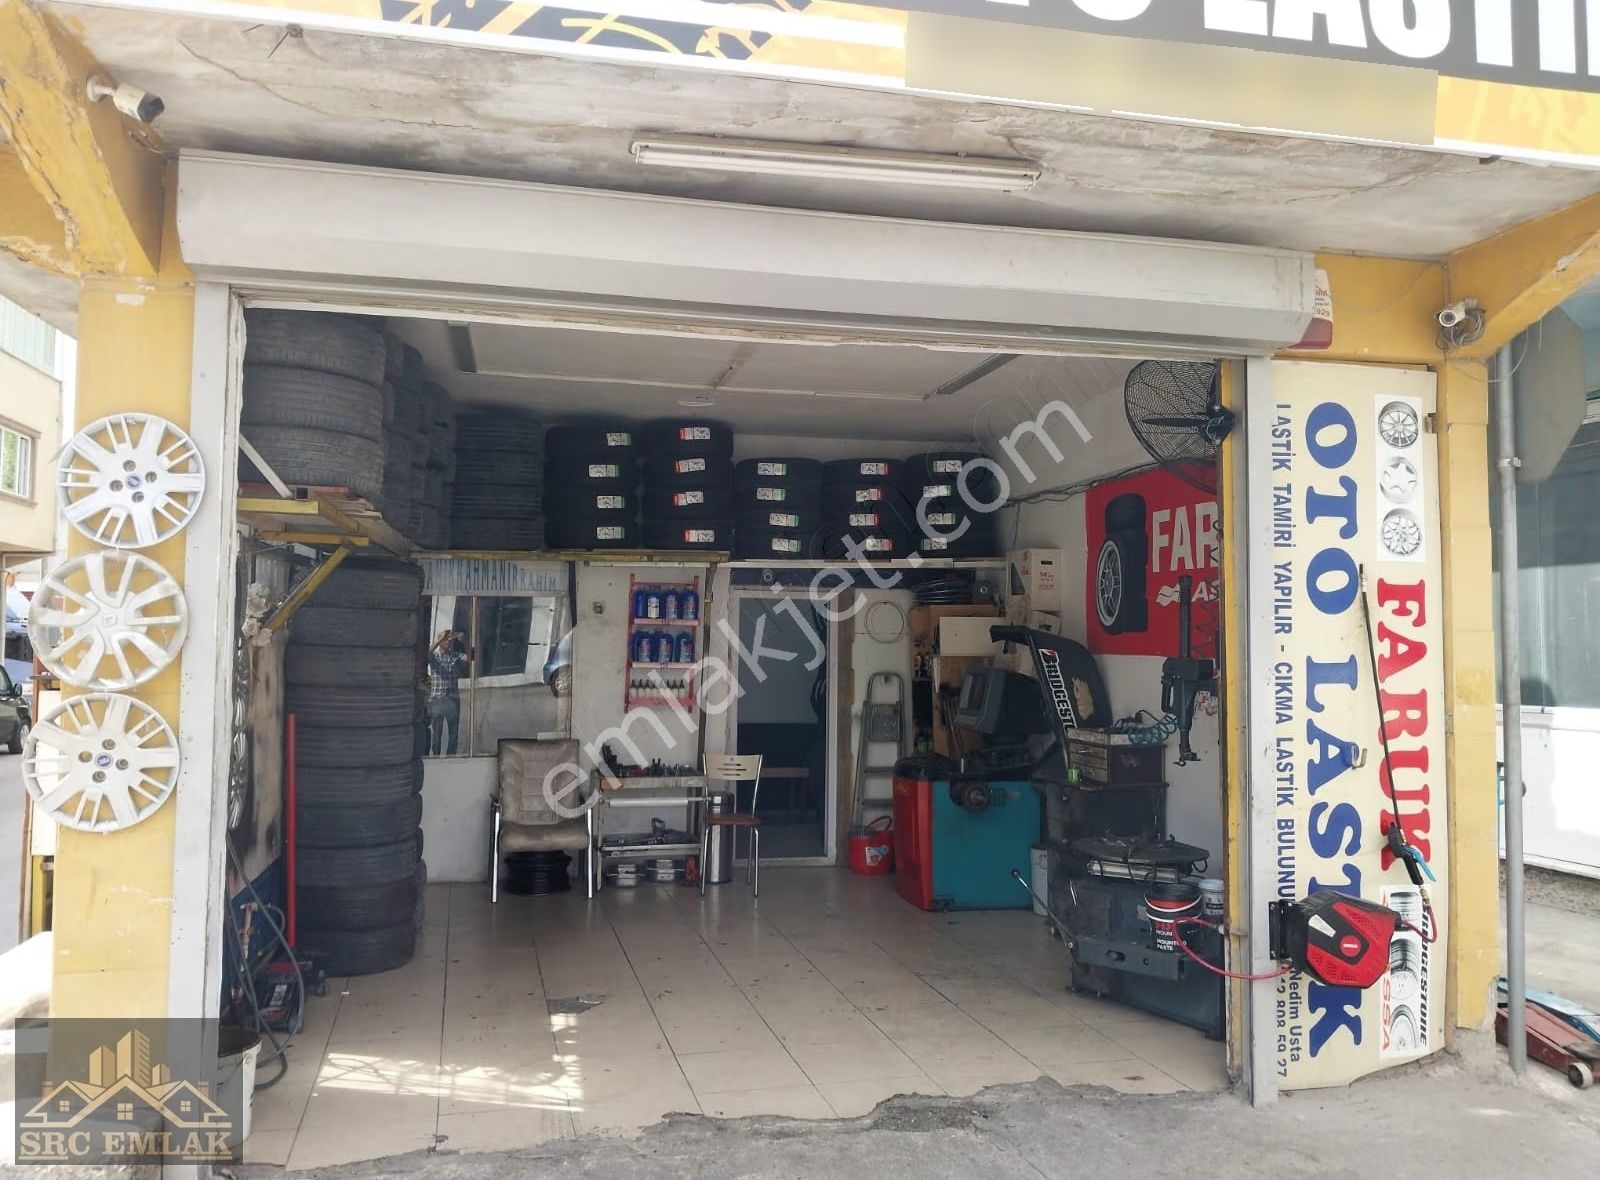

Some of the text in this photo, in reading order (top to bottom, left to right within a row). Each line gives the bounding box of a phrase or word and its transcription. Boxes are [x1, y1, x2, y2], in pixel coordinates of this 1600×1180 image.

[1272, 483, 1297, 548] TAMİRİ
[1274, 561, 1293, 635] YAPILIR
[1305, 401, 1363, 1058] OTO LASTK
[1376, 577, 1432, 872] FARUK
[1275, 736, 1299, 808] LASTİK
[1289, 967, 1302, 1062] Nedim Usta
